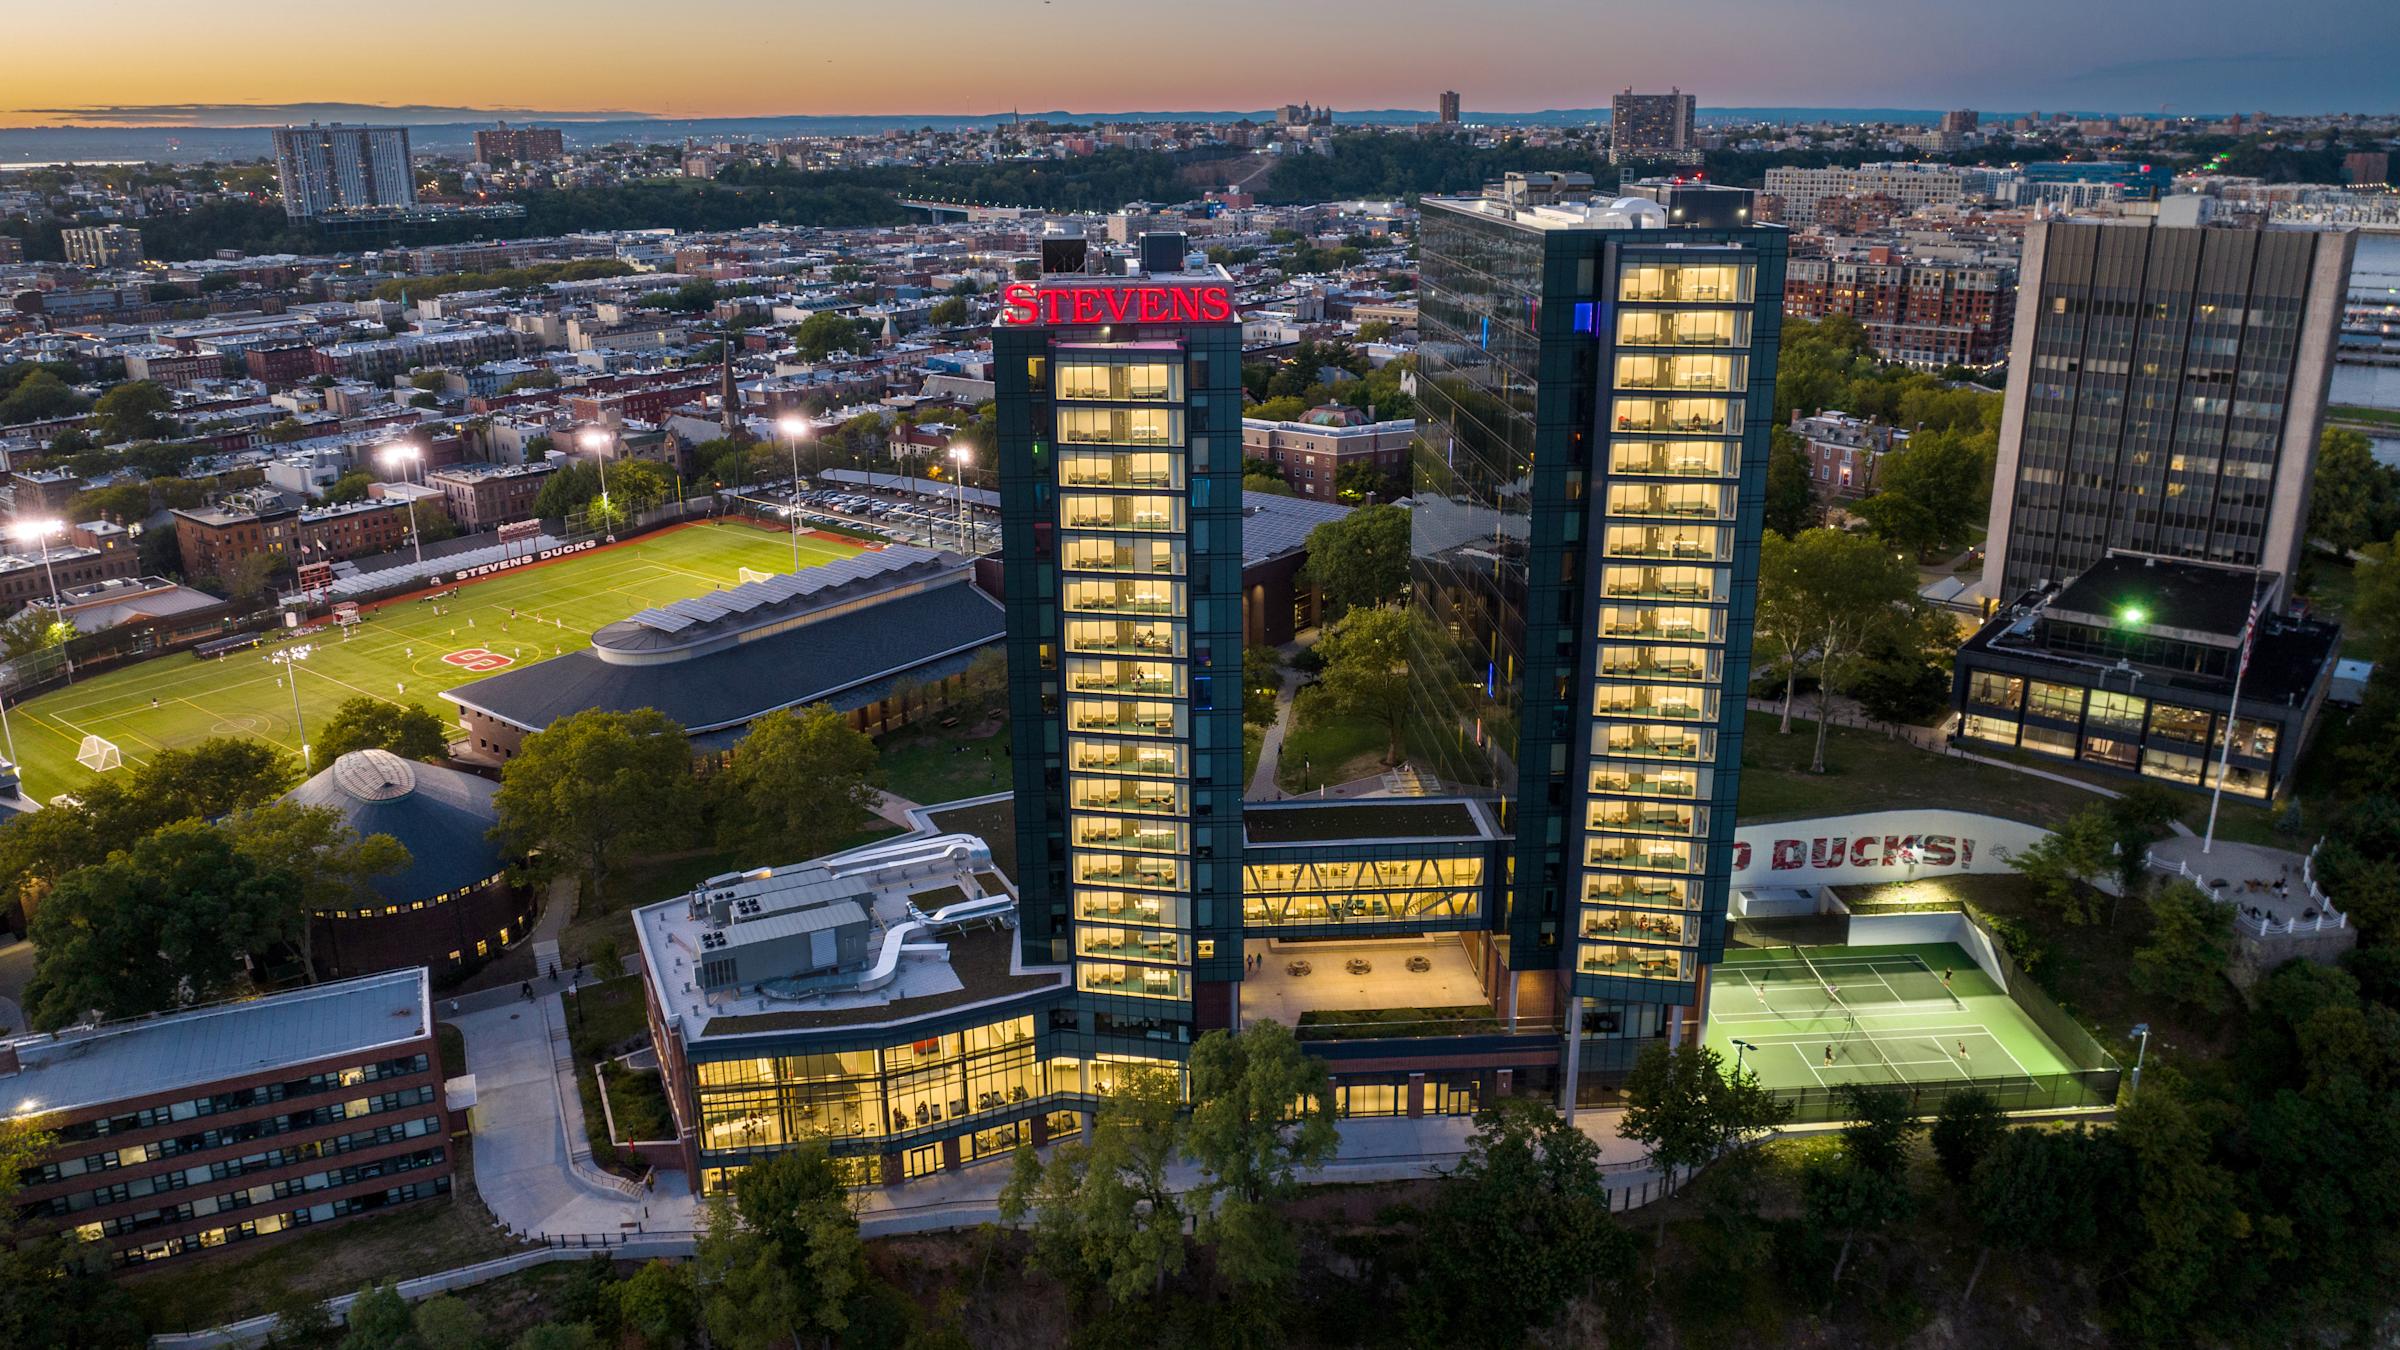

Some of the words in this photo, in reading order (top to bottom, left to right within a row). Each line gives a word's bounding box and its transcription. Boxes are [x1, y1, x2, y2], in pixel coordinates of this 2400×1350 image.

[1004, 284, 1231, 324] STEVENS
[456, 555, 533, 580] STEVENS
[540, 539, 597, 560] DUCKS
[441, 648, 515, 671] S
[1771, 833, 1976, 871] DUCKS!
